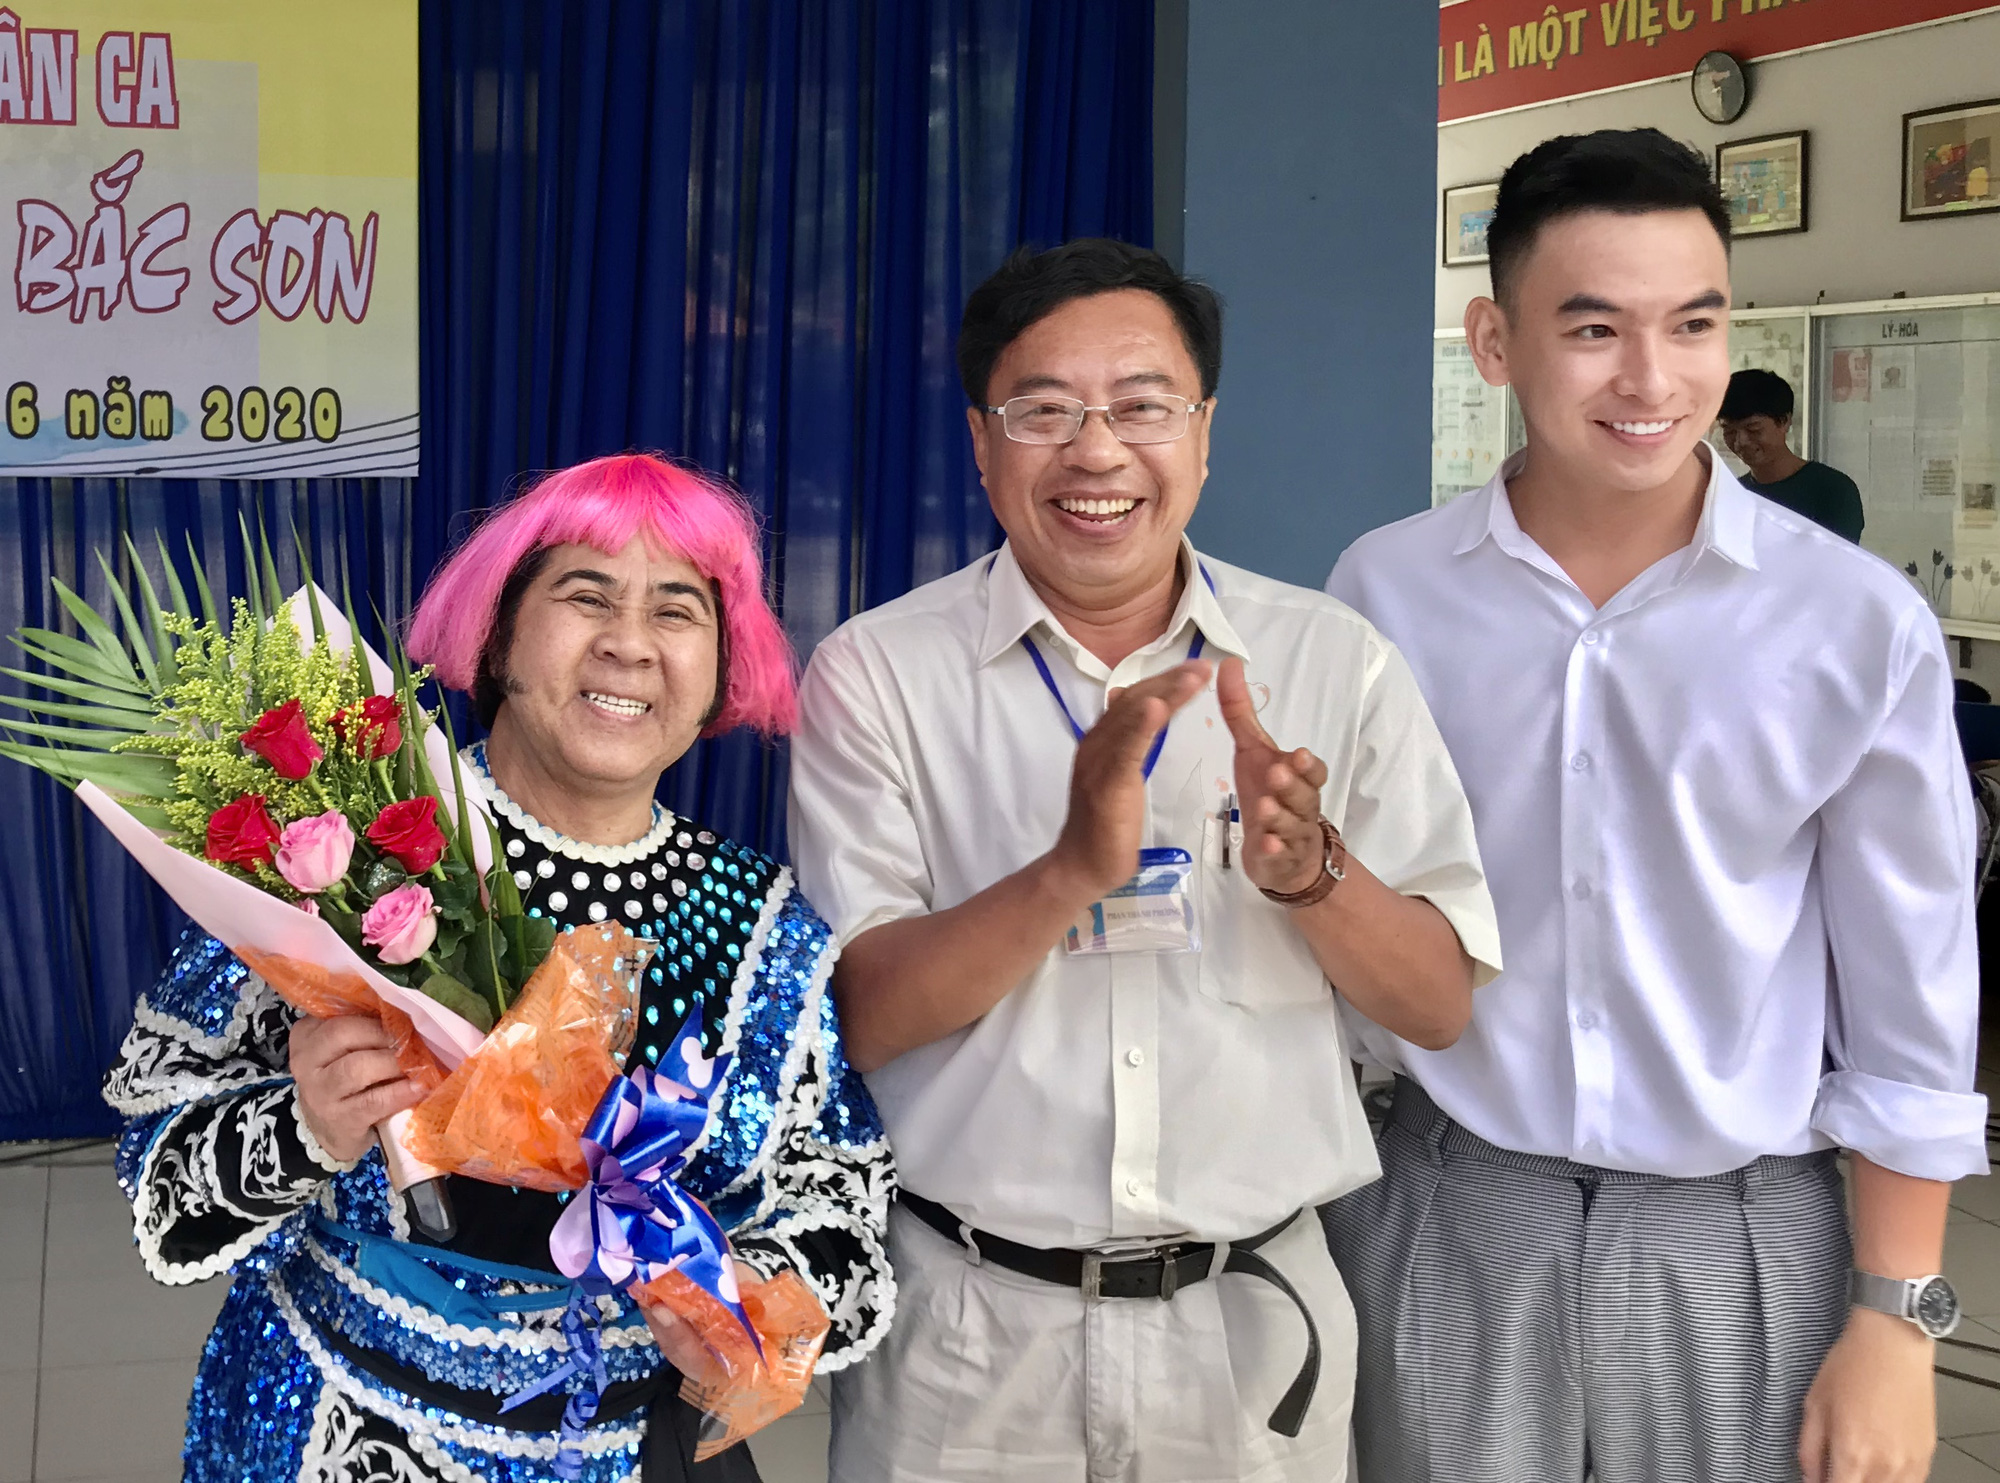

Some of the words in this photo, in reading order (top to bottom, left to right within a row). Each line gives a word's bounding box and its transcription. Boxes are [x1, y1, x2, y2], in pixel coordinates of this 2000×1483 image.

[96, 31, 179, 129] CA
[1455, 23, 1495, 82] LÀ
[1508, 4, 1588, 70] MỘT
[15, 149, 190, 324] BẮC
[210, 207, 379, 325] SƠN
[6, 381, 40, 440] 6
[65, 375, 173, 441] năm
[201, 385, 342, 443] 2020
